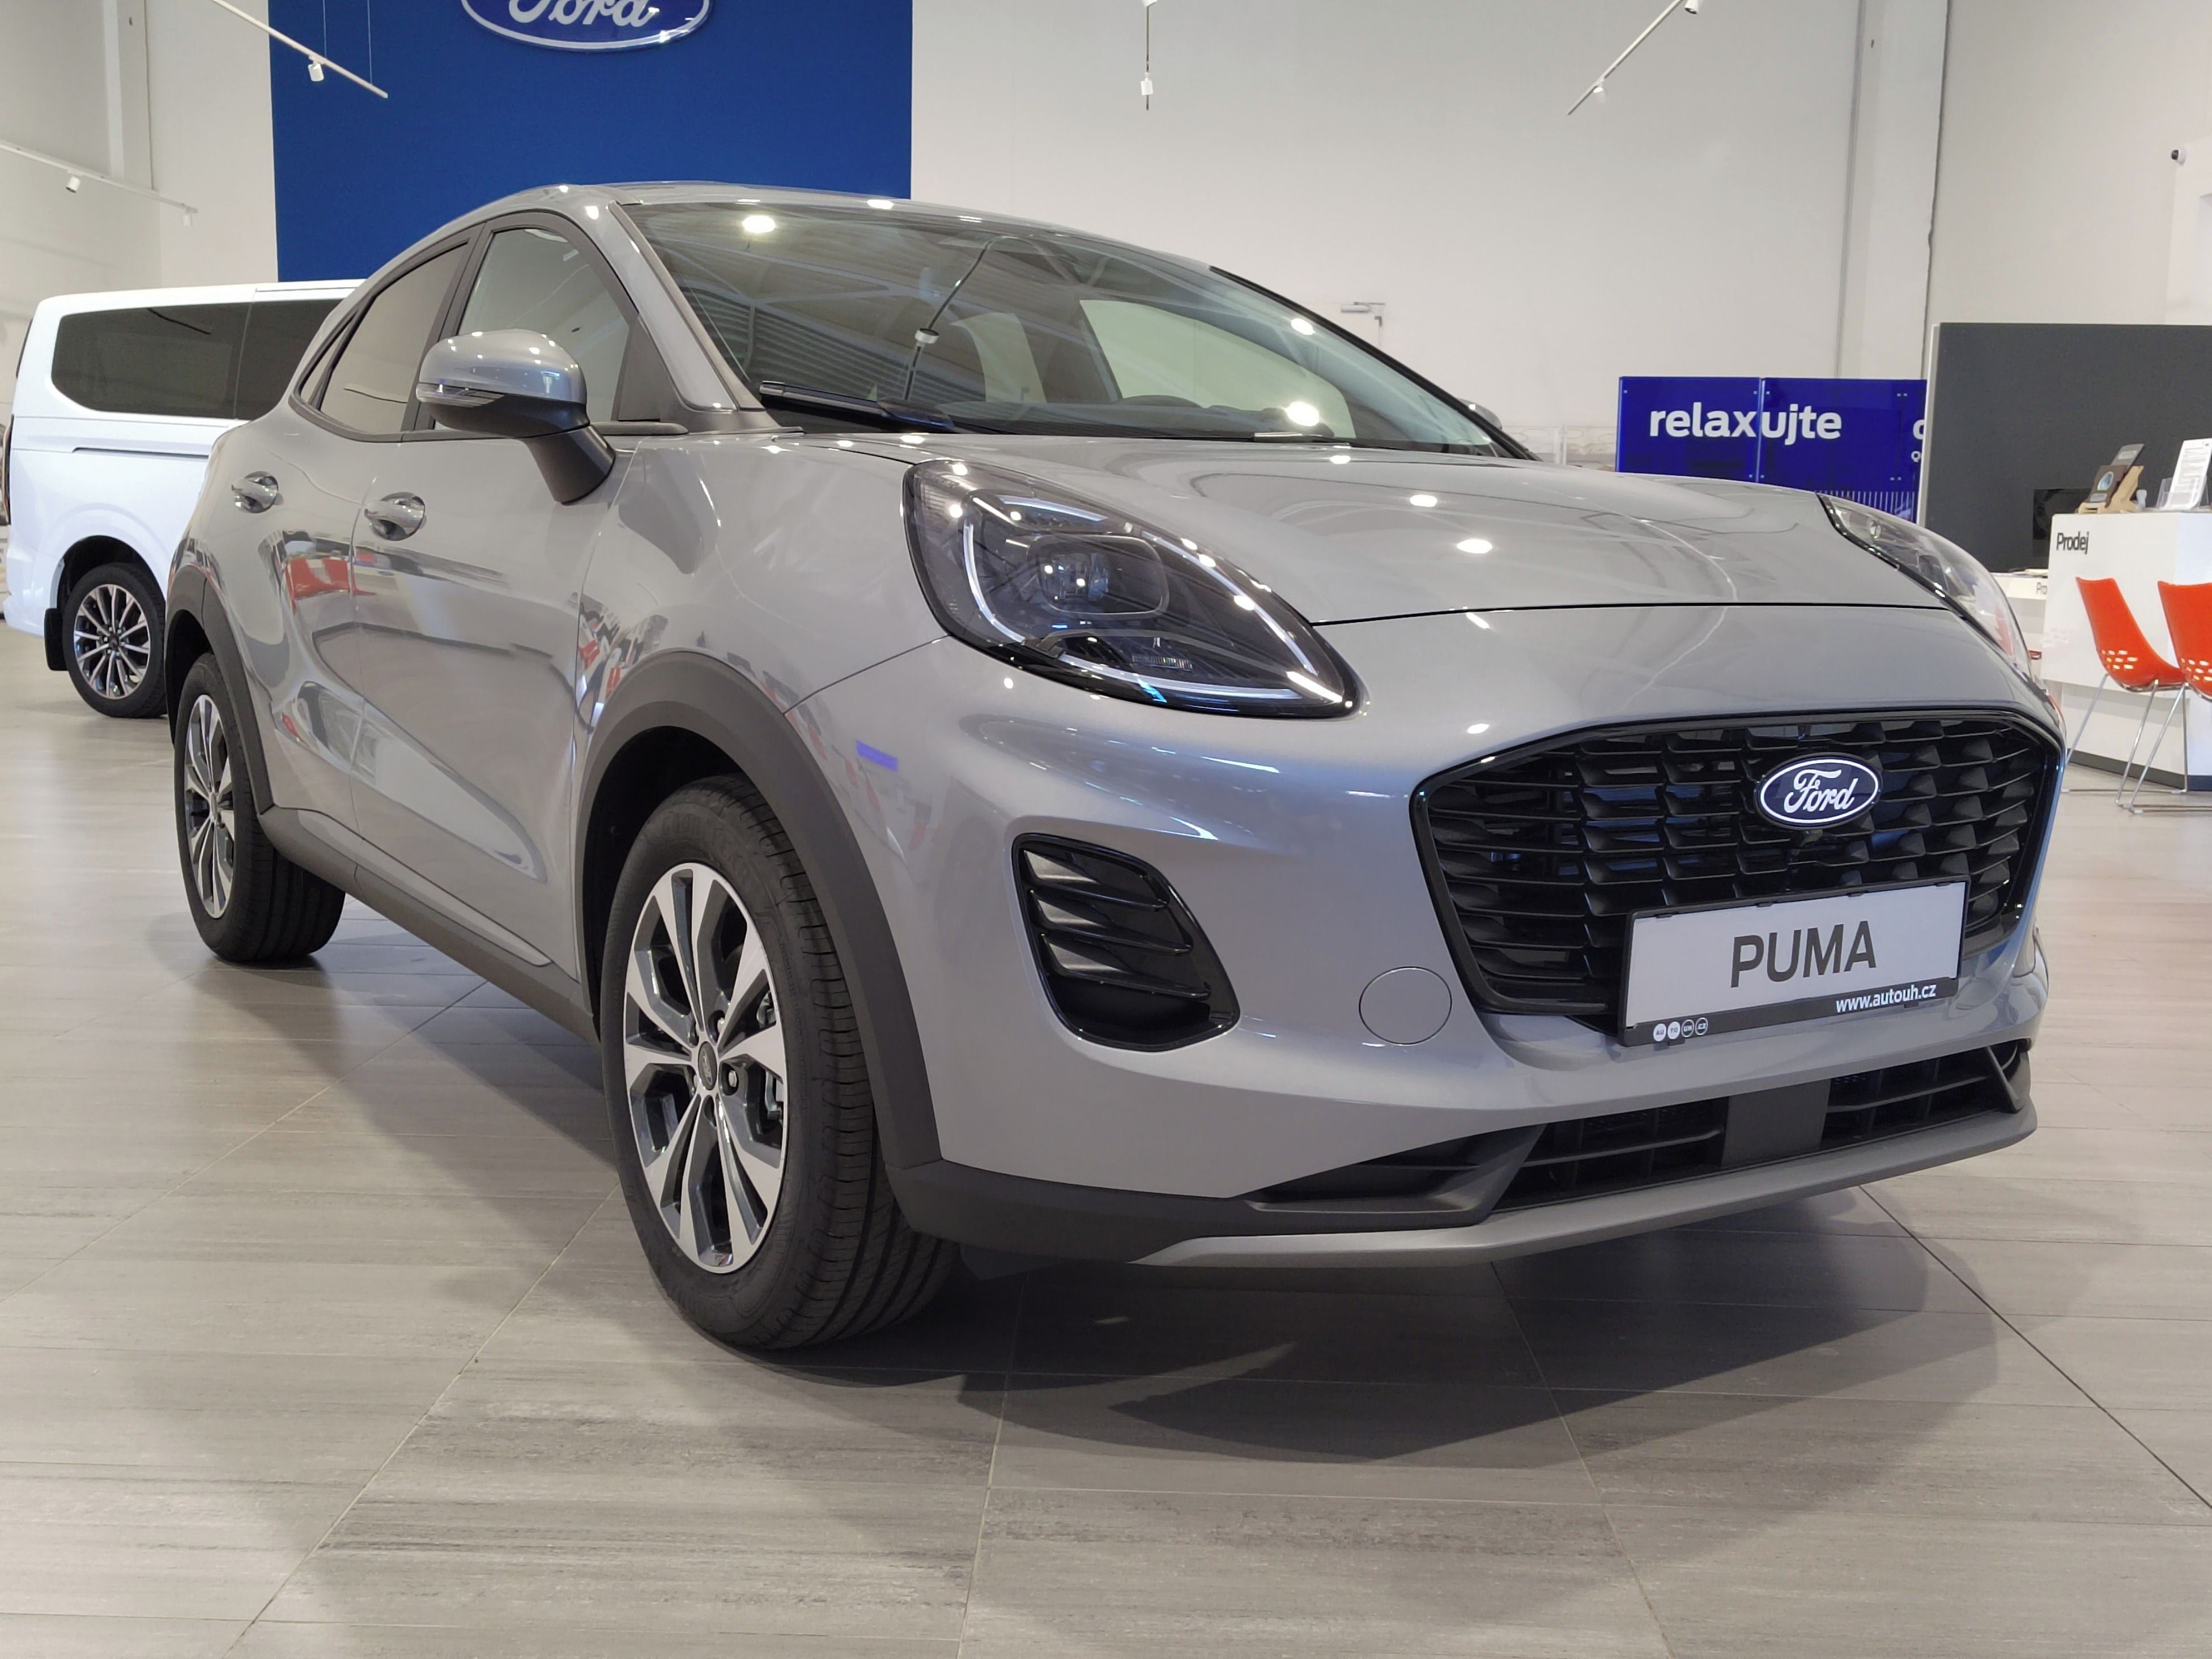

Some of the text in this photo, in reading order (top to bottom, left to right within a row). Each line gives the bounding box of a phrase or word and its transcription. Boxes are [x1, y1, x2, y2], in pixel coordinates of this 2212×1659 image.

[1650, 402, 1841, 445] relaxujte
[2056, 531, 2089, 555] Prodej
[1784, 769, 1858, 813] Ford
[1731, 921, 1877, 988] PUMA
[1836, 984, 1937, 1013] www.autouh.cz
